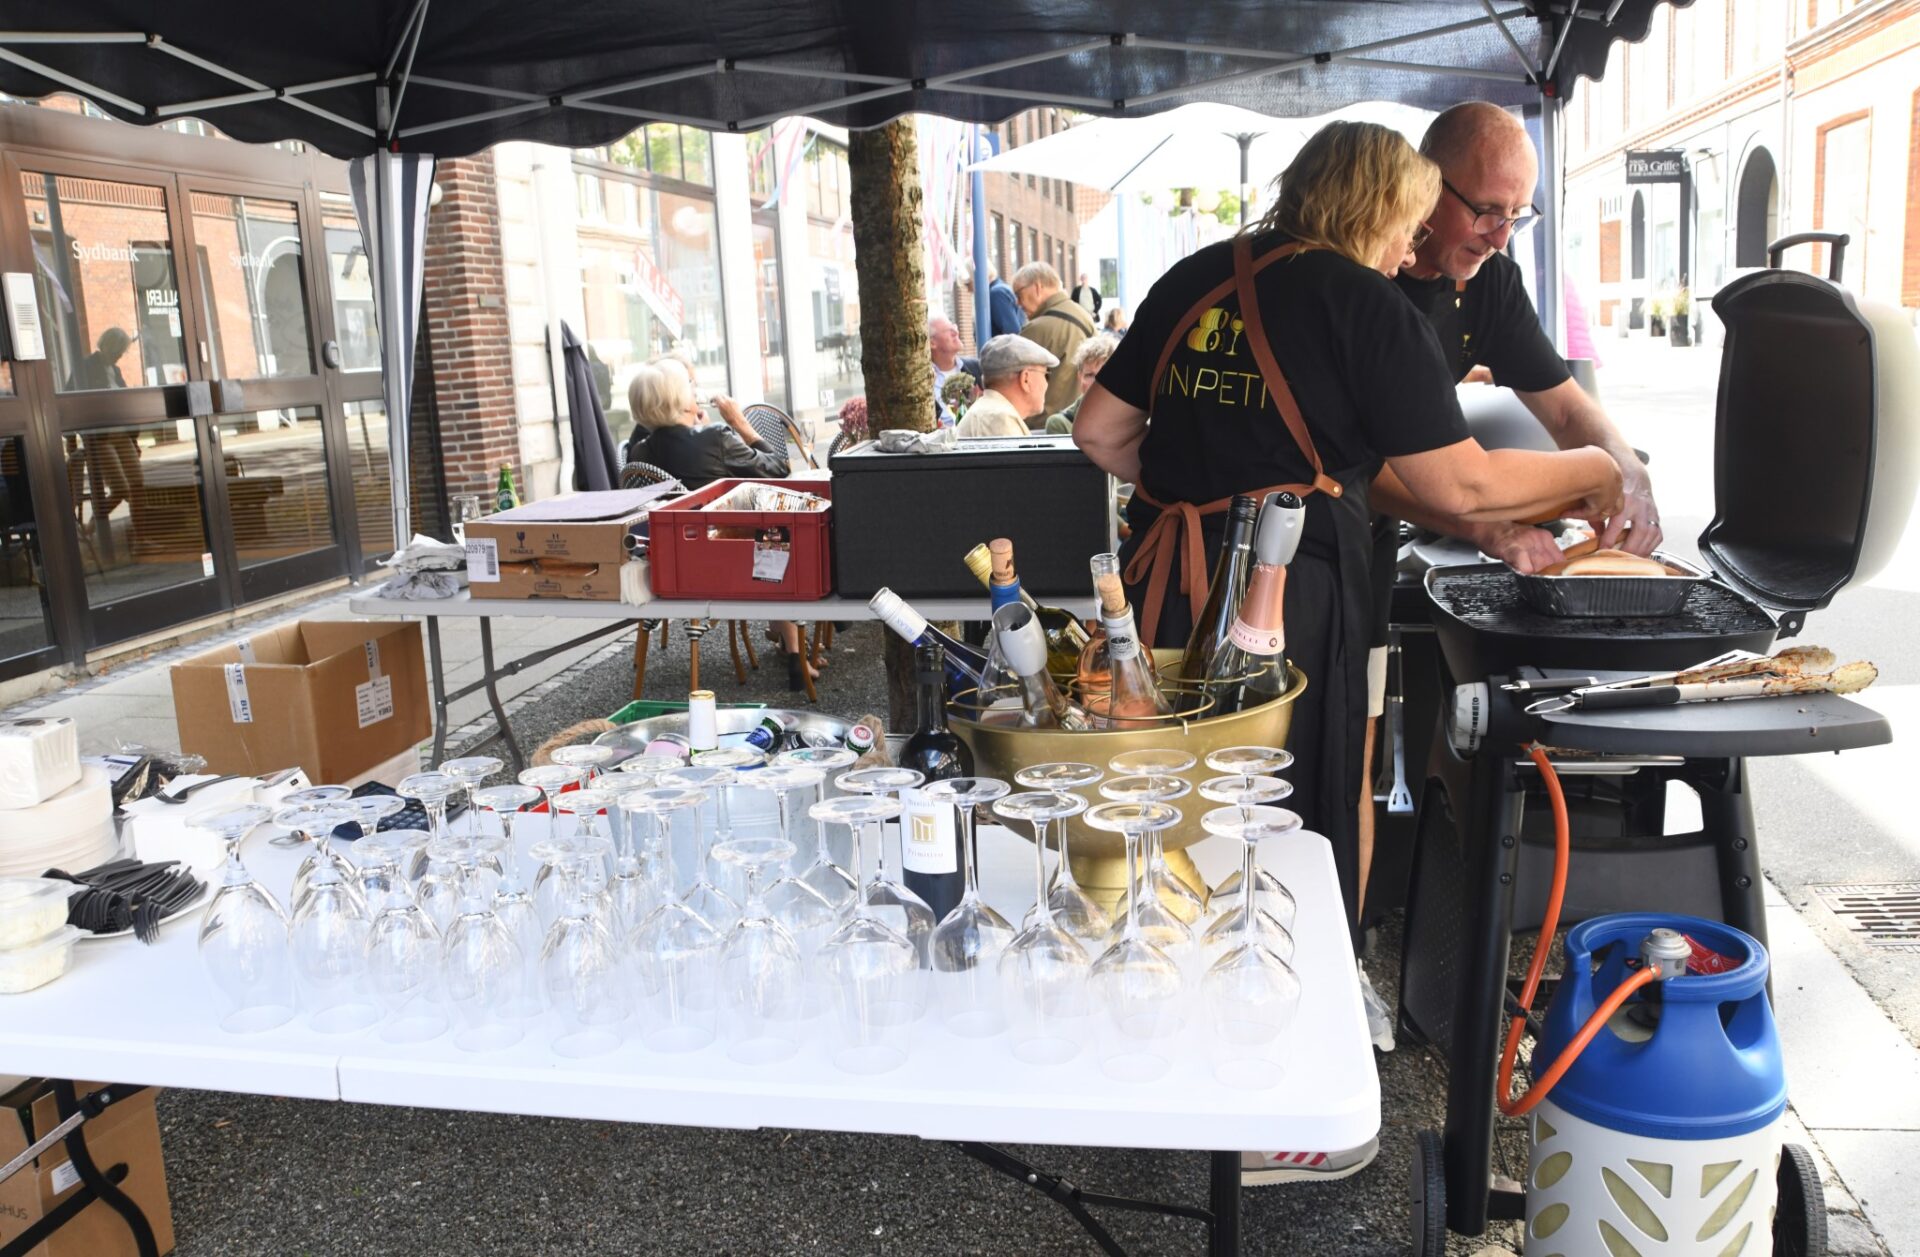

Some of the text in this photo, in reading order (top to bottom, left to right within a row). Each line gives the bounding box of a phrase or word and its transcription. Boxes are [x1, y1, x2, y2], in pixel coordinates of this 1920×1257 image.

[1651, 161, 1680, 171] Griffe
[71, 240, 140, 265] Sydbank
[228, 251, 275, 269] Sydbank
